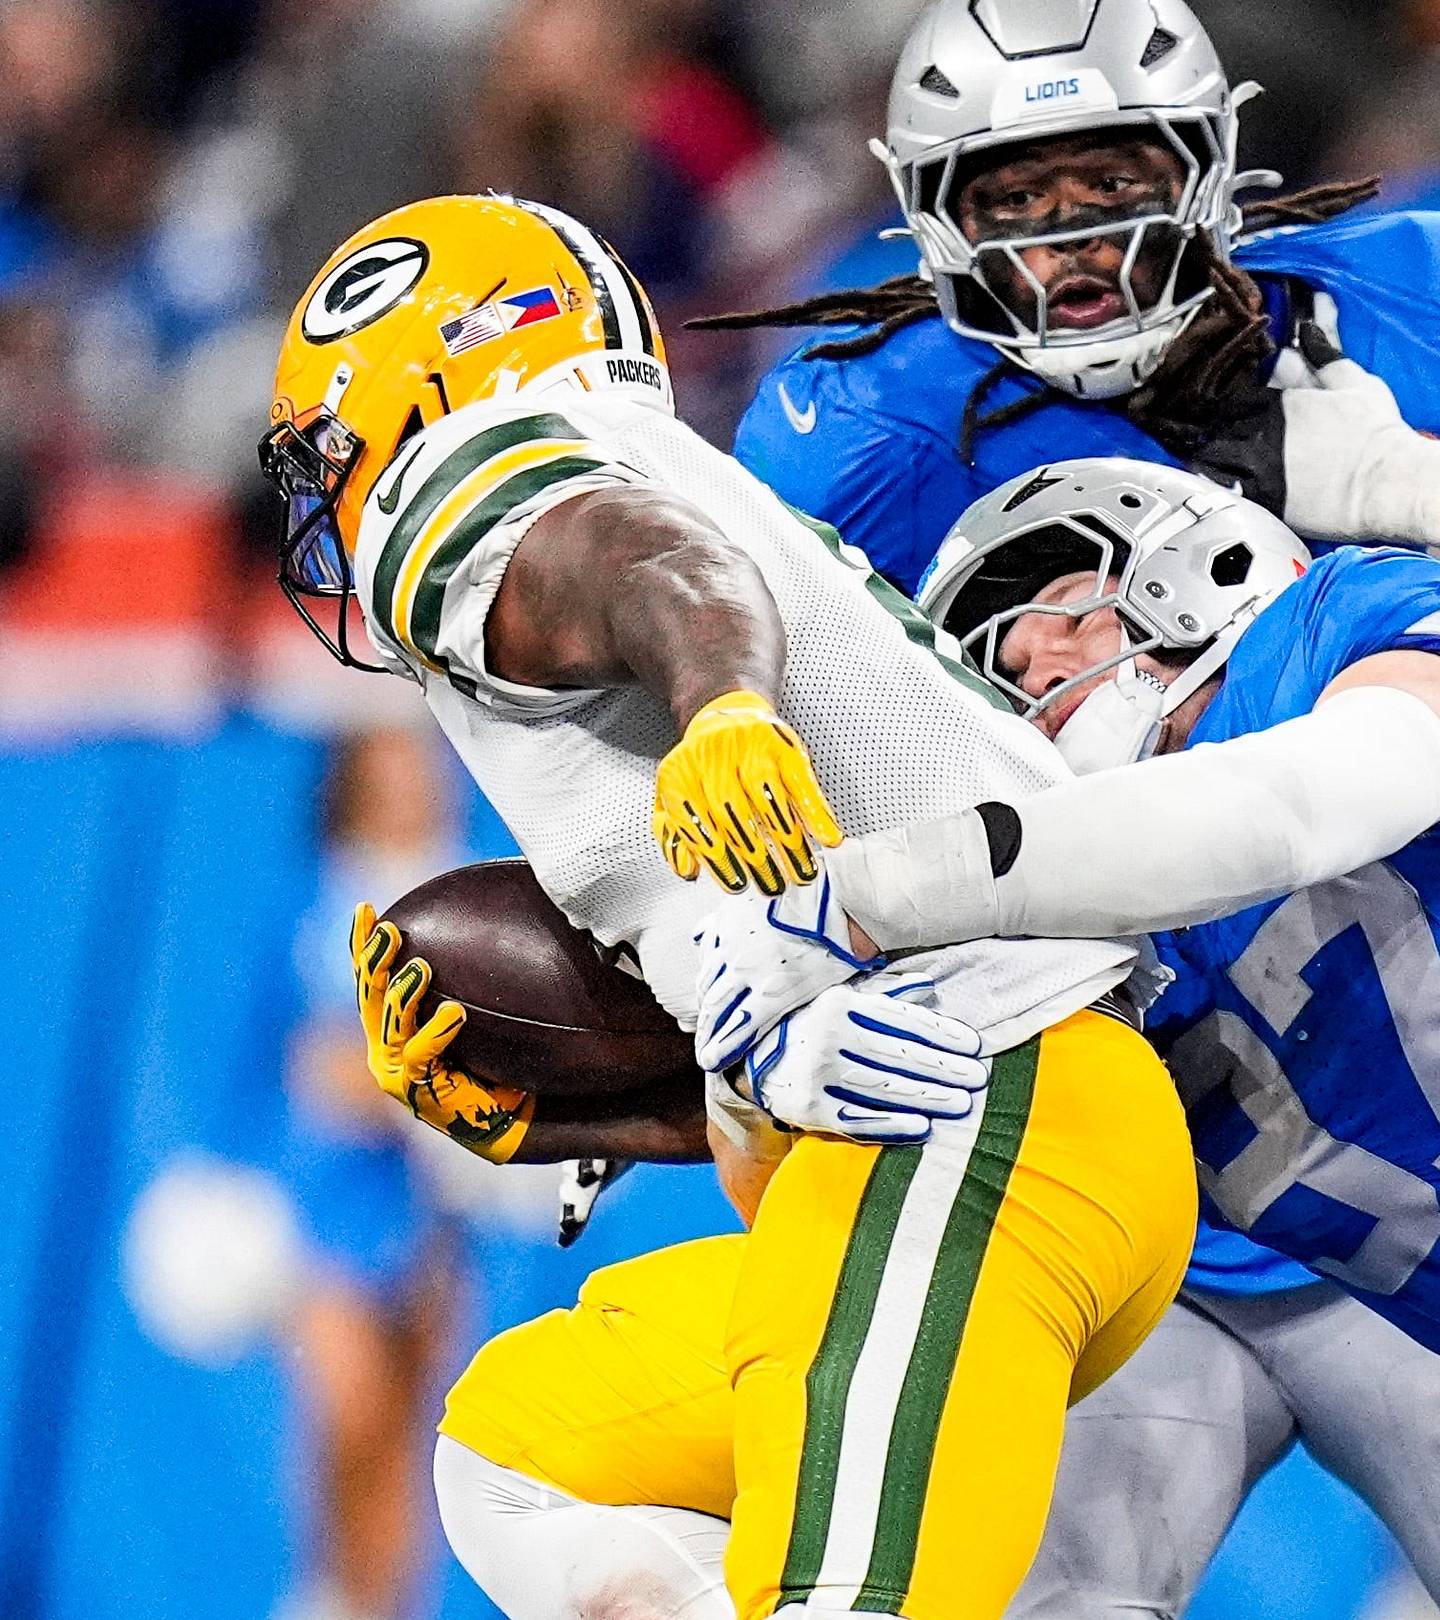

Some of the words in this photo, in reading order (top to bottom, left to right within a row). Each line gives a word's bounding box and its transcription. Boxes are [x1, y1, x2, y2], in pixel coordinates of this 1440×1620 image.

[1025, 78, 1079, 102] LIONS
[303, 238, 428, 343] G
[606, 359, 661, 391] PACKERS
